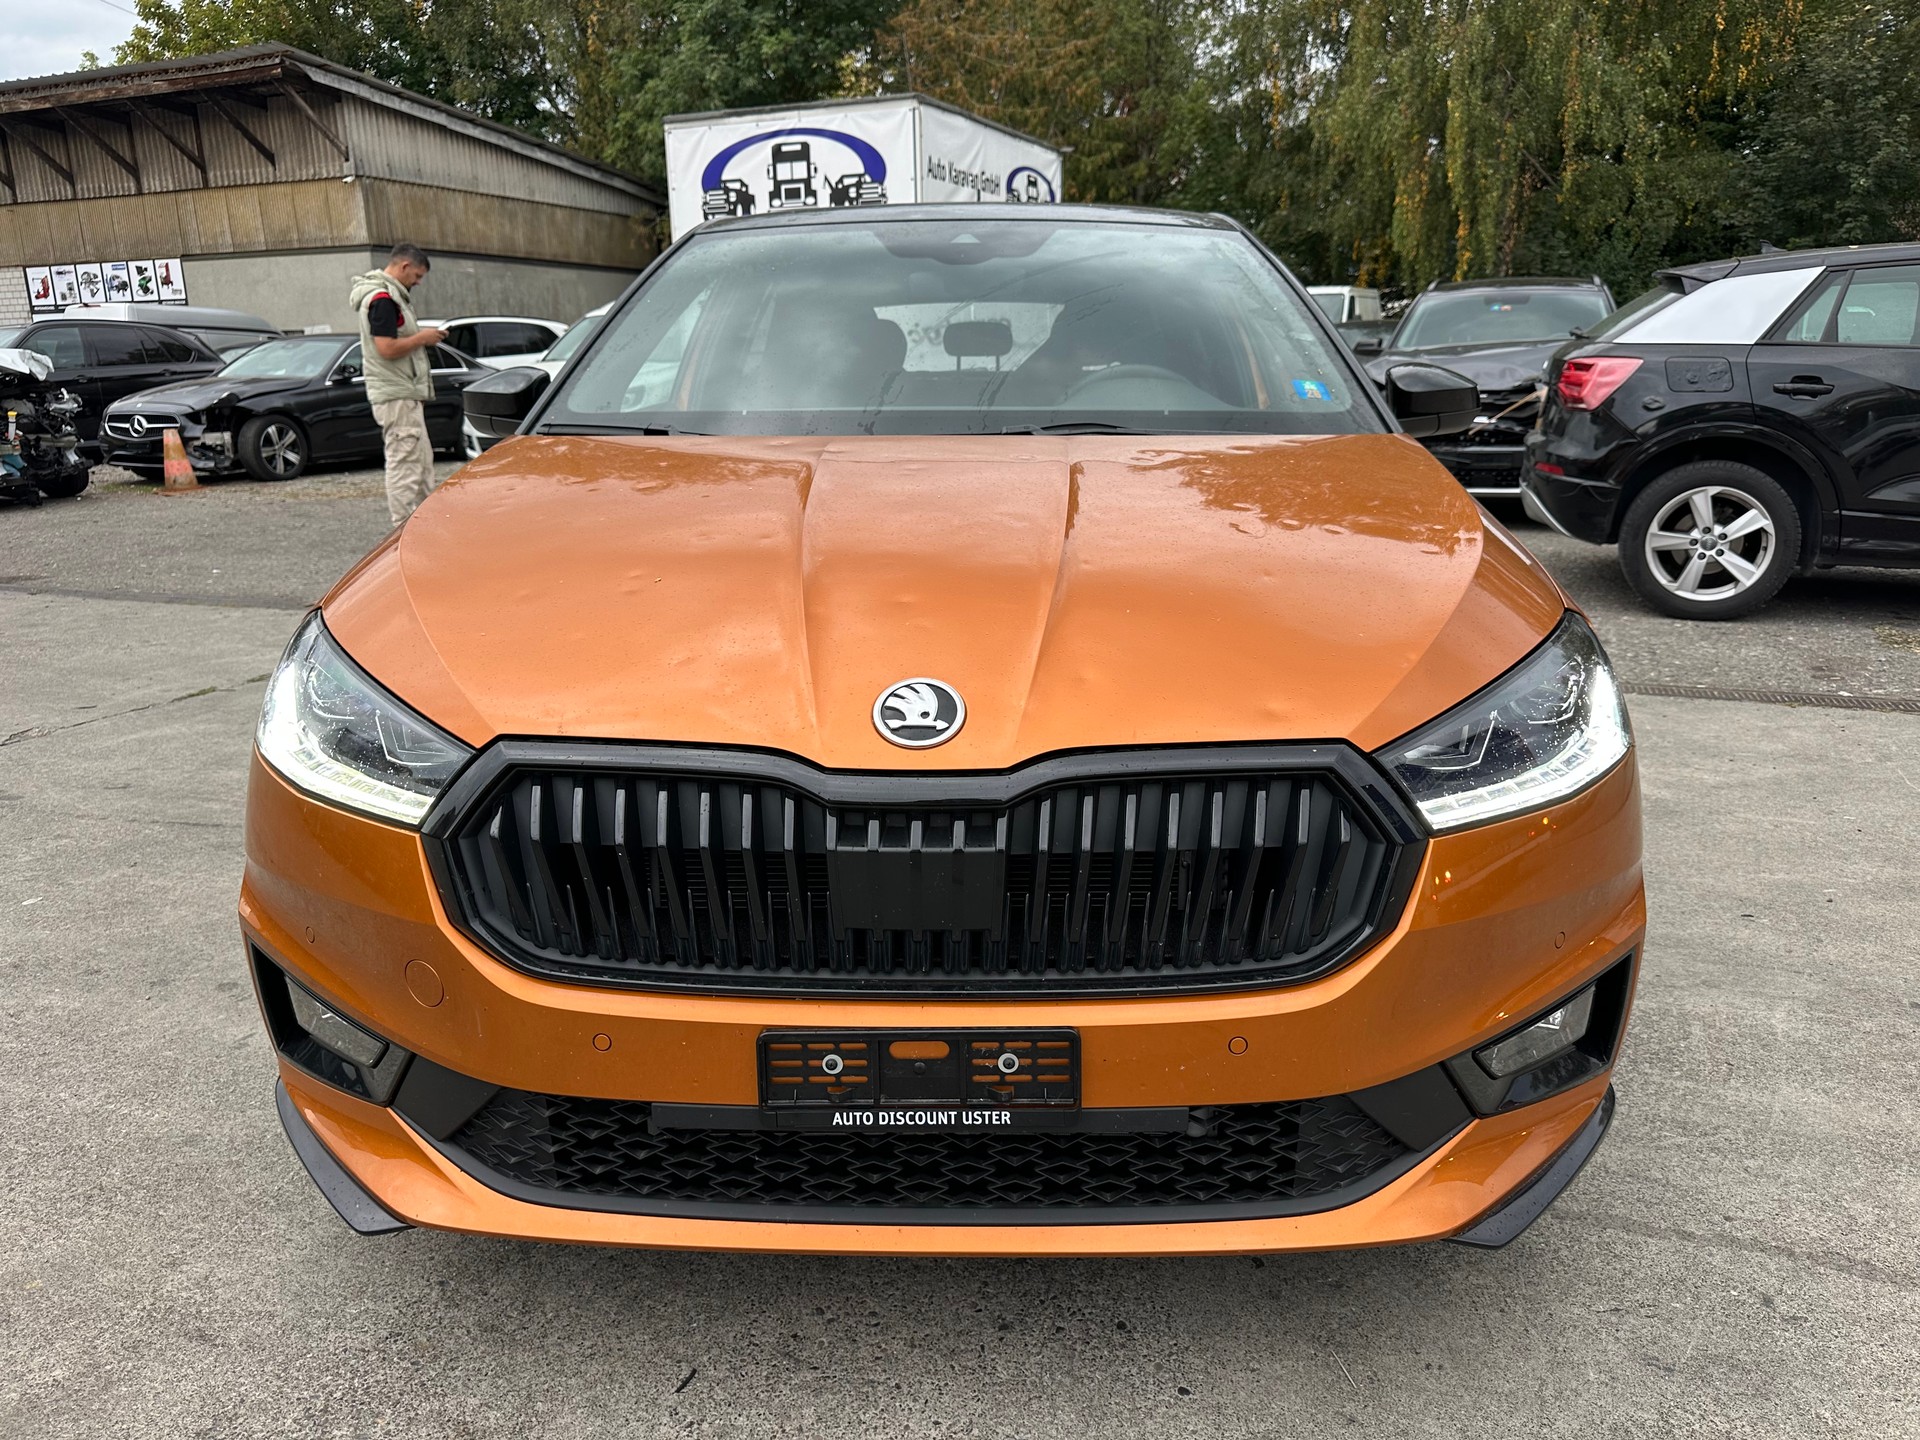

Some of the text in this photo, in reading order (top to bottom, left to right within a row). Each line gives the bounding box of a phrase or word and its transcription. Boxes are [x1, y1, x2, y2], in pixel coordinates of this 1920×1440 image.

[927, 155, 1001, 197] Auto Karavan GmbH
[832, 1110, 1011, 1126] AUTO DISCOUNT USTER
